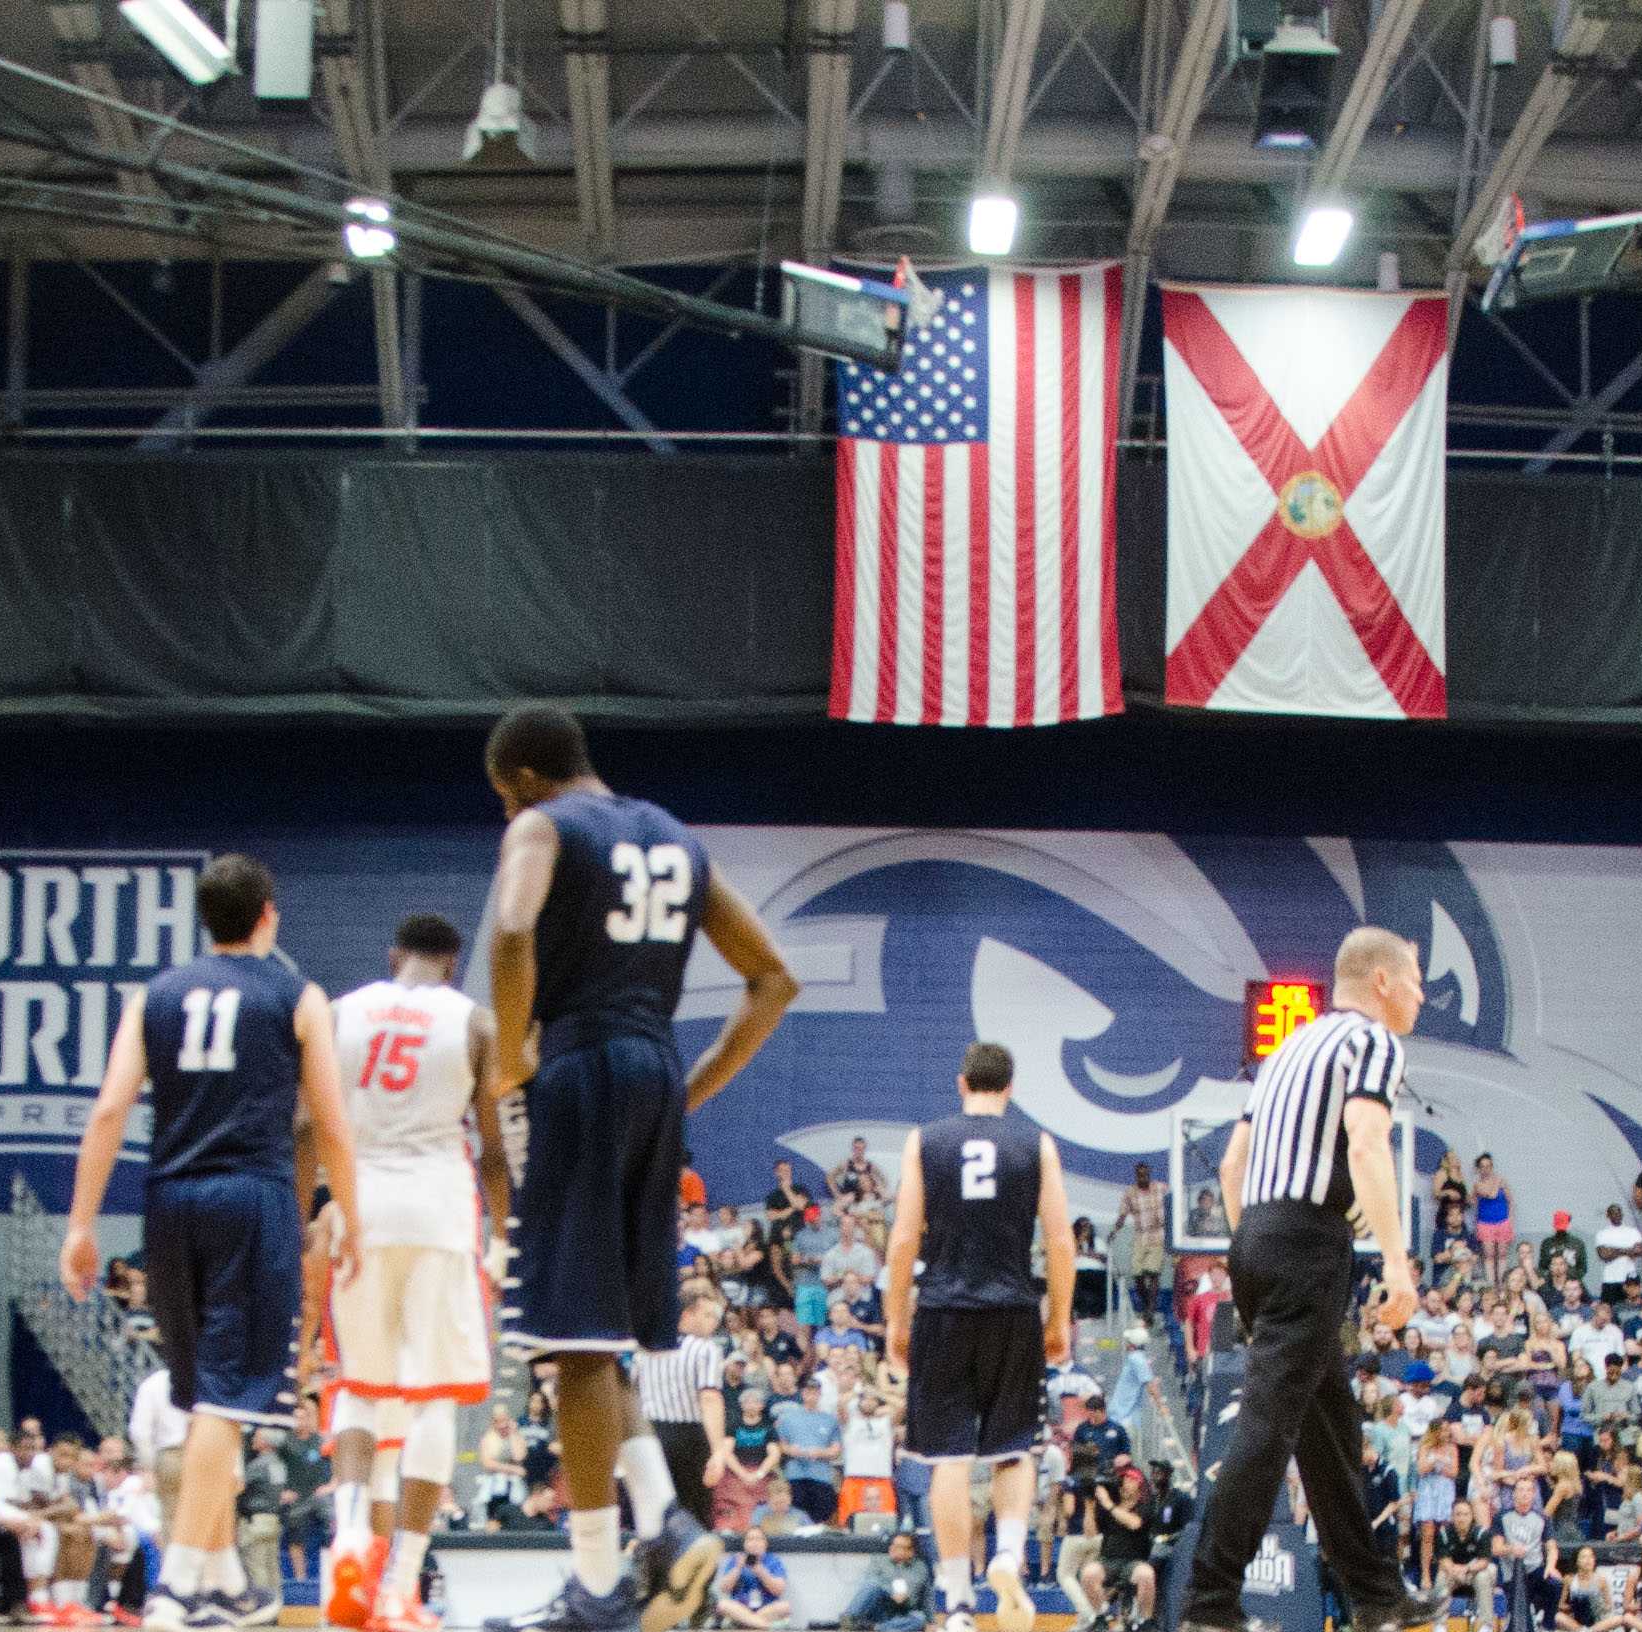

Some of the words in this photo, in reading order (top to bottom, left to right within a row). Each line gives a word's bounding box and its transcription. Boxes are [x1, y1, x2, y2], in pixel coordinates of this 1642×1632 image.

[606, 841, 693, 943] 32
[177, 987, 241, 1071] 11
[357, 1030, 427, 1092] 15
[961, 1139, 996, 1200] 2
